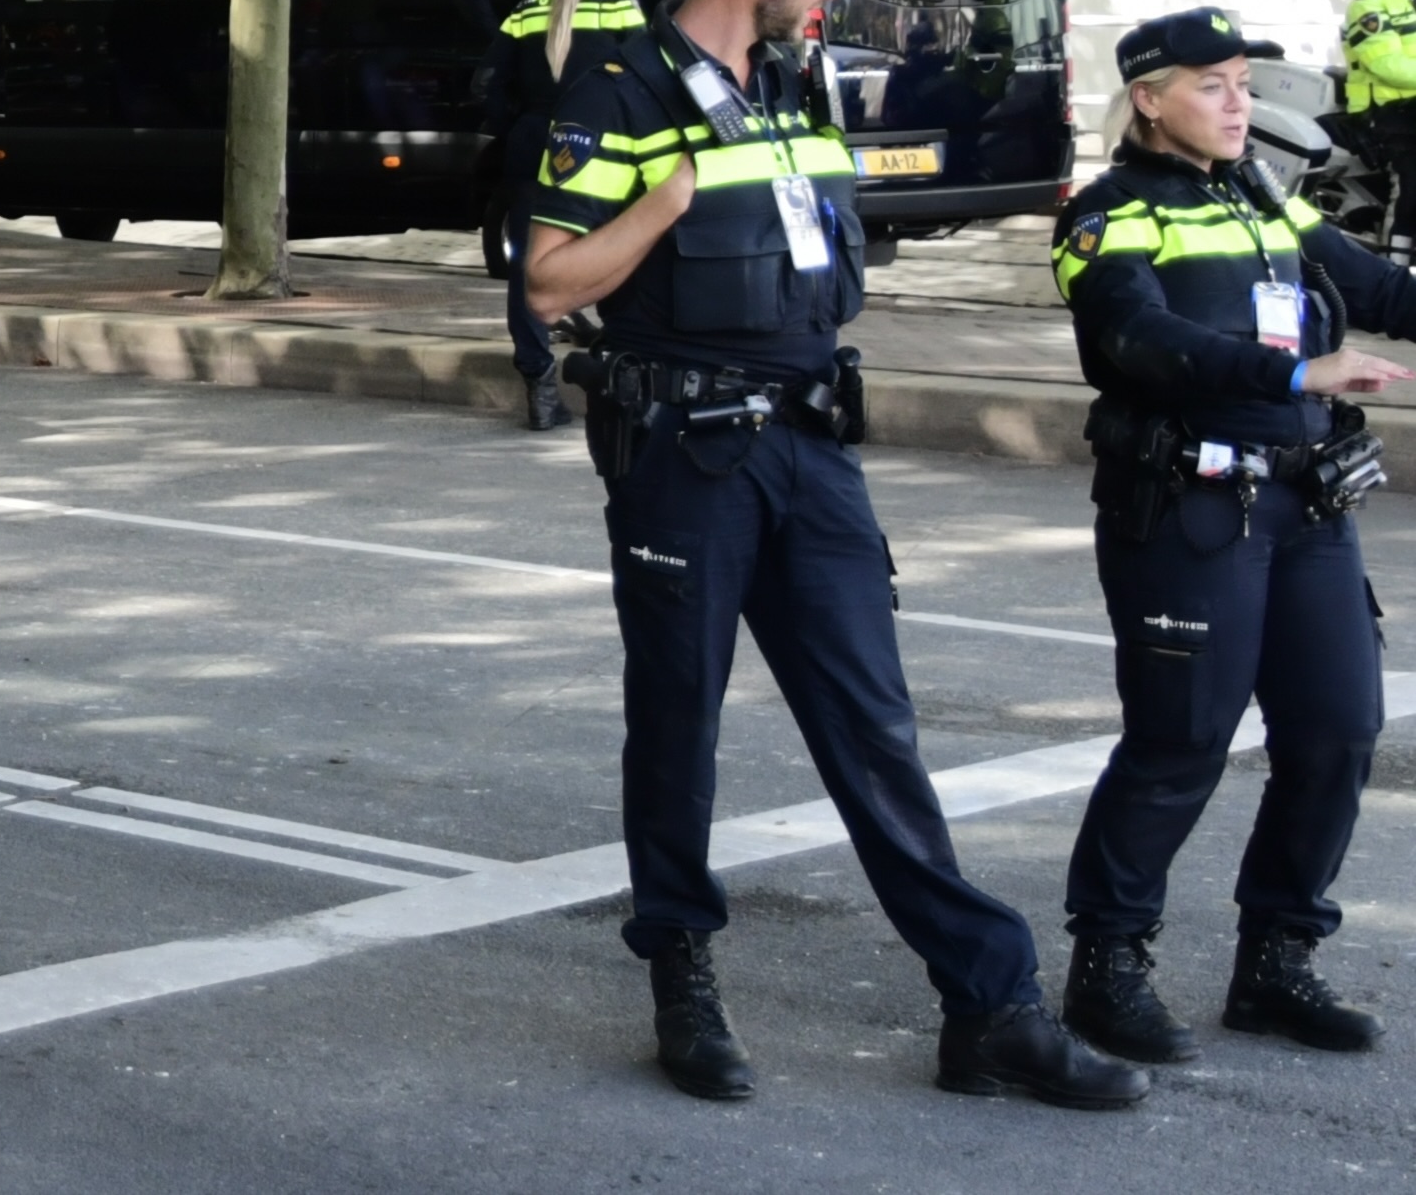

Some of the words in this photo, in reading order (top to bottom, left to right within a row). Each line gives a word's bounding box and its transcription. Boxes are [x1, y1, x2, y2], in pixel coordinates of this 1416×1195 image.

[1278, 79, 1292, 91] 24
[880, 152, 919, 171] AA-12
[637, 546, 676, 565] POLITIE
[1153, 614, 1197, 630] POLITIE
